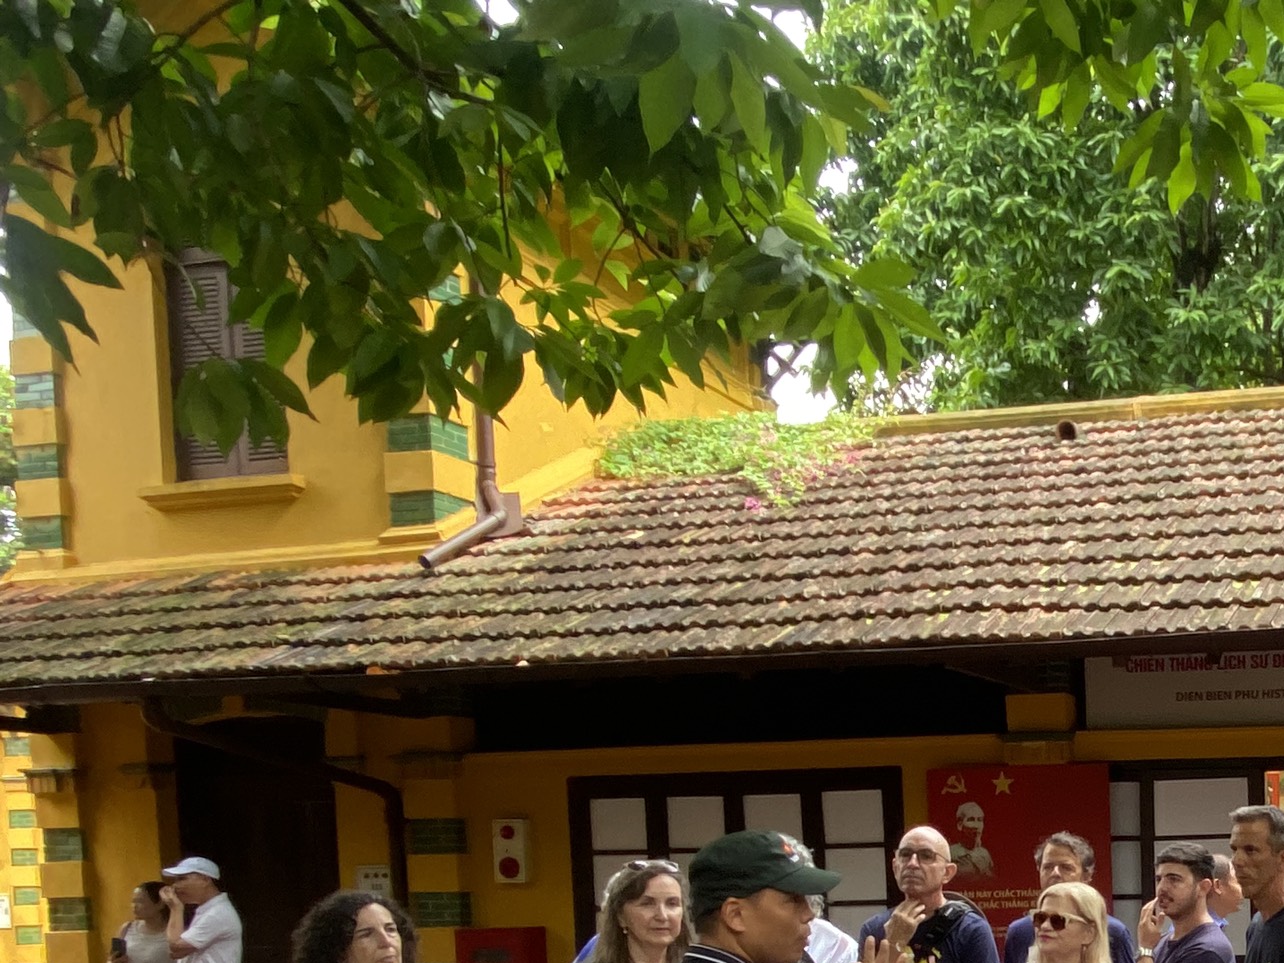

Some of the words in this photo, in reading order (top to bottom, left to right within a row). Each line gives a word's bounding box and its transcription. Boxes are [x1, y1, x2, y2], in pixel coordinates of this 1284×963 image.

[1175, 691, 1203, 702] DIEN
[1206, 690, 1232, 701] BIEN
[1235, 689, 1259, 700] PHU
